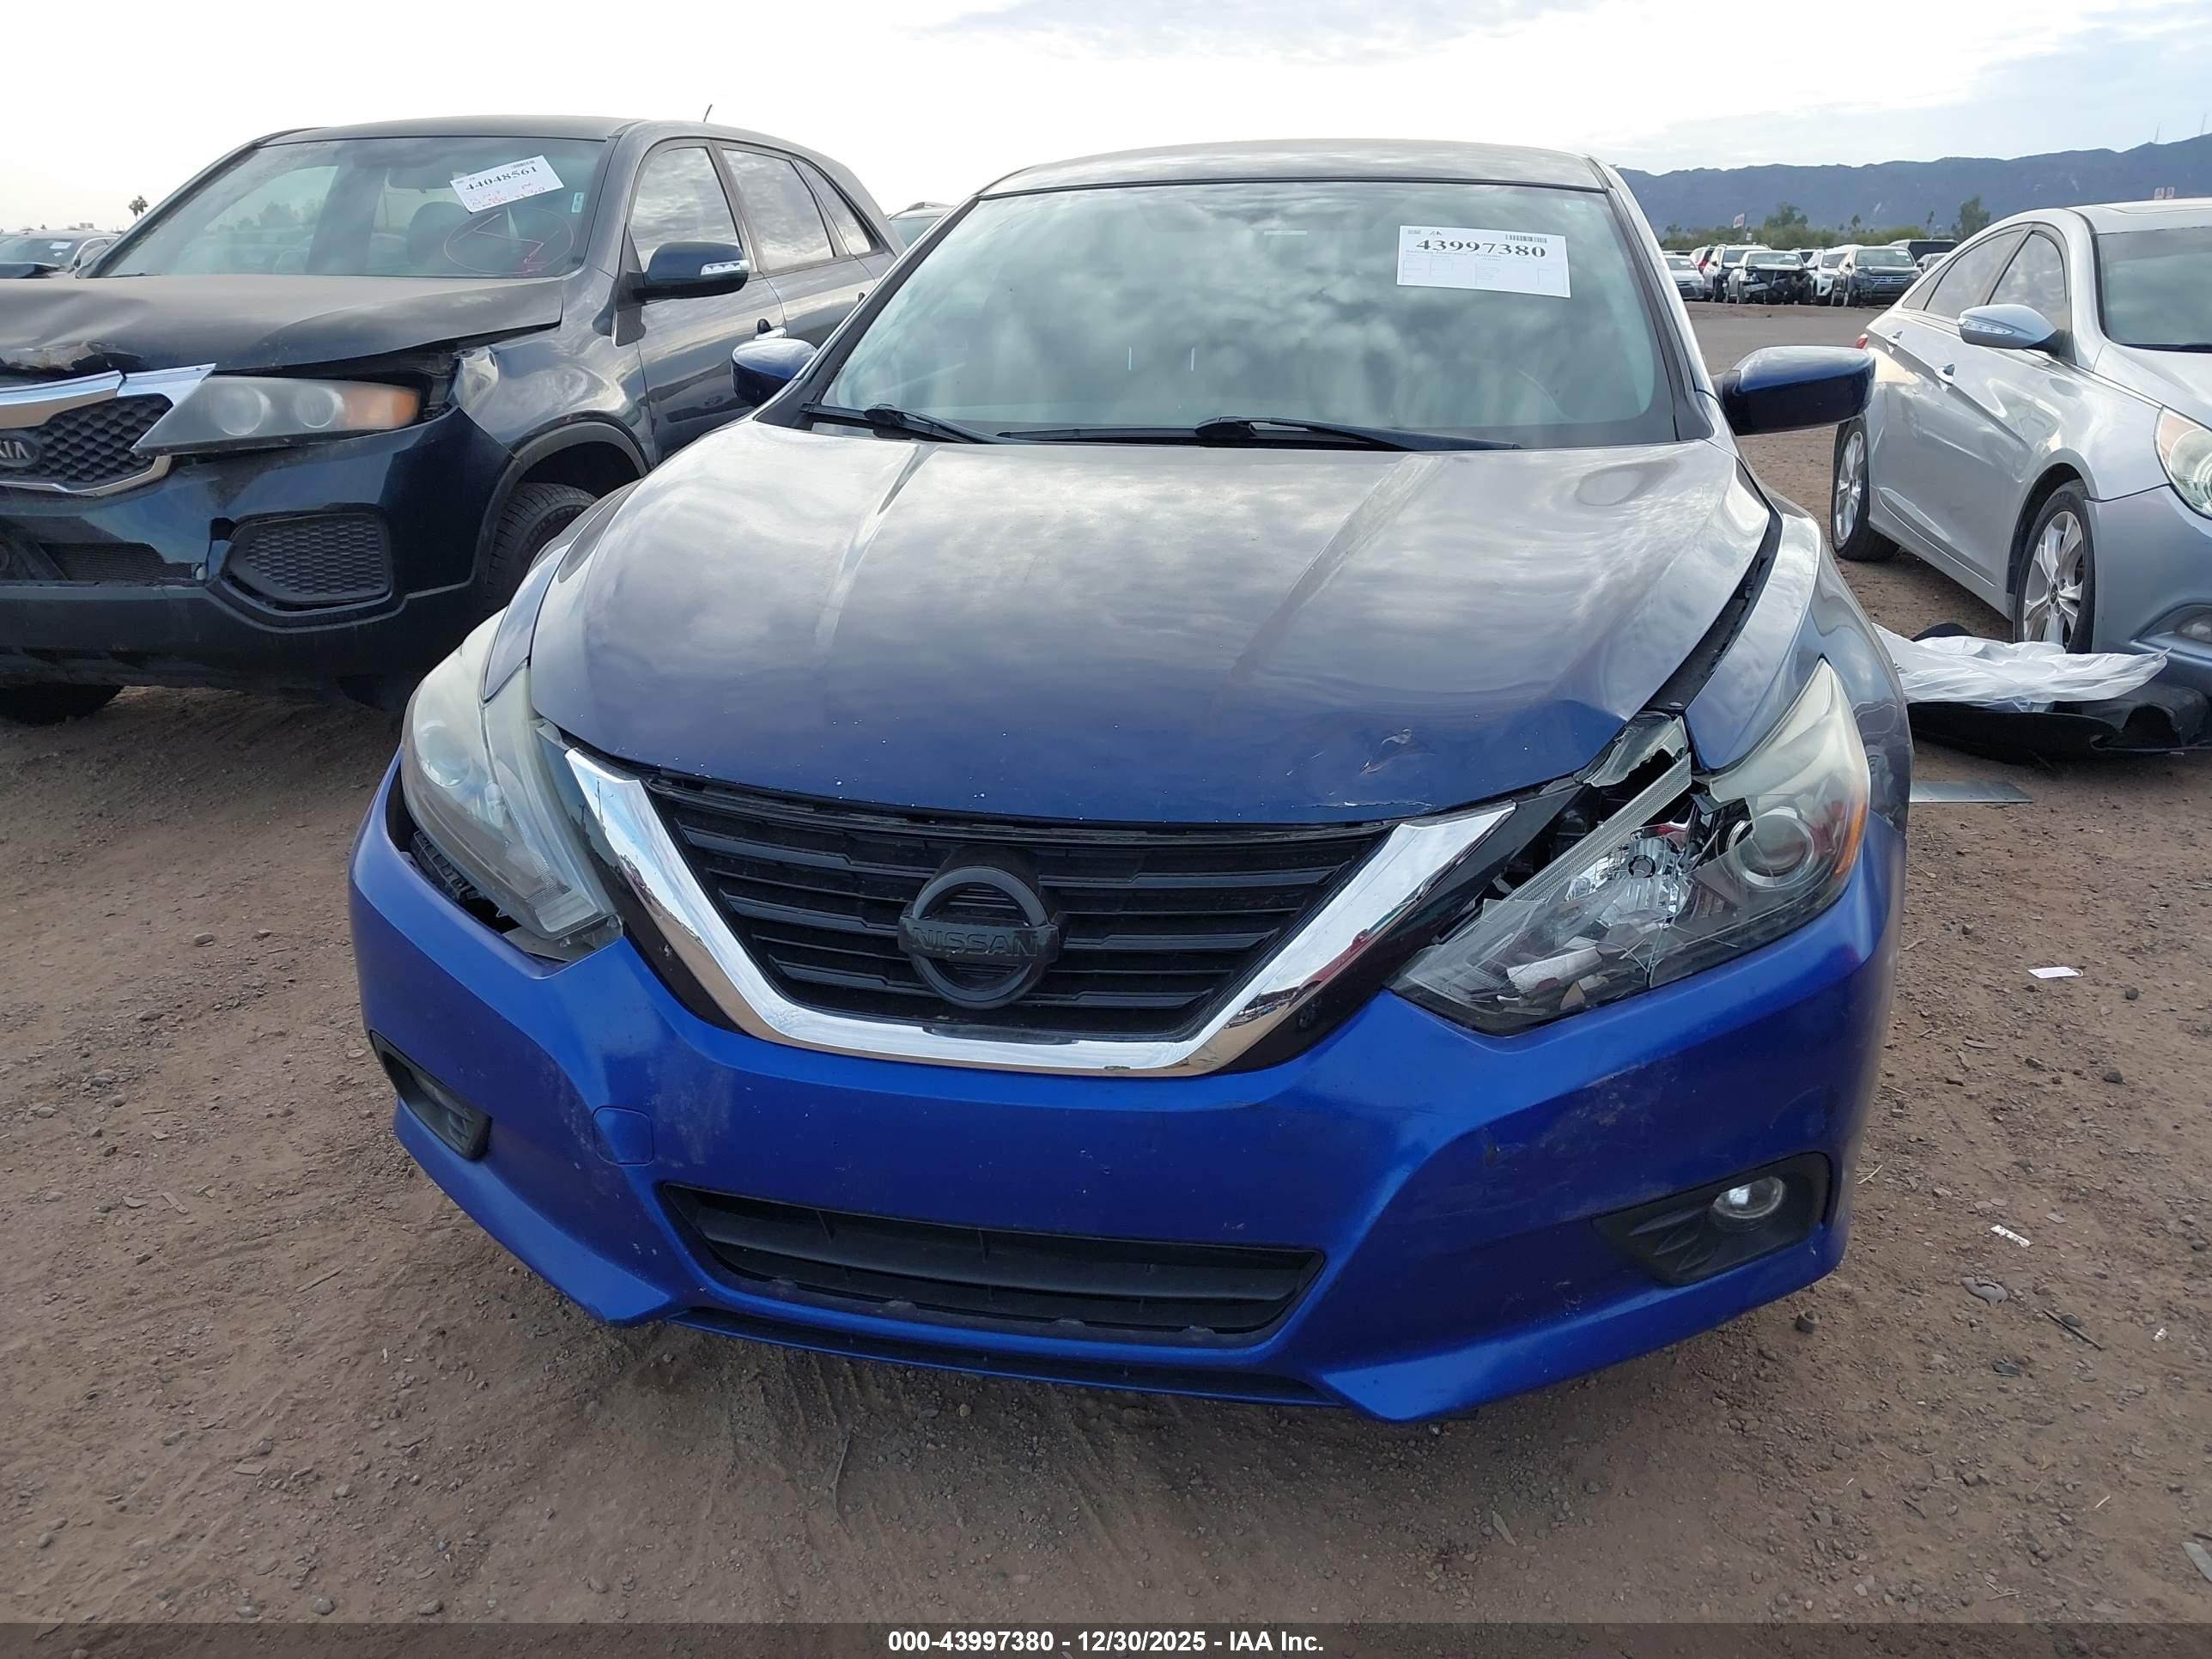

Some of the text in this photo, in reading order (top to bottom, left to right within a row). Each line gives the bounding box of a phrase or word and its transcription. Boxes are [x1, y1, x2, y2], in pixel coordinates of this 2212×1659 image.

[465, 166, 538, 191] 44048561
[1415, 238, 1547, 258] 43997380
[912, 927, 1038, 957] NISSAN
